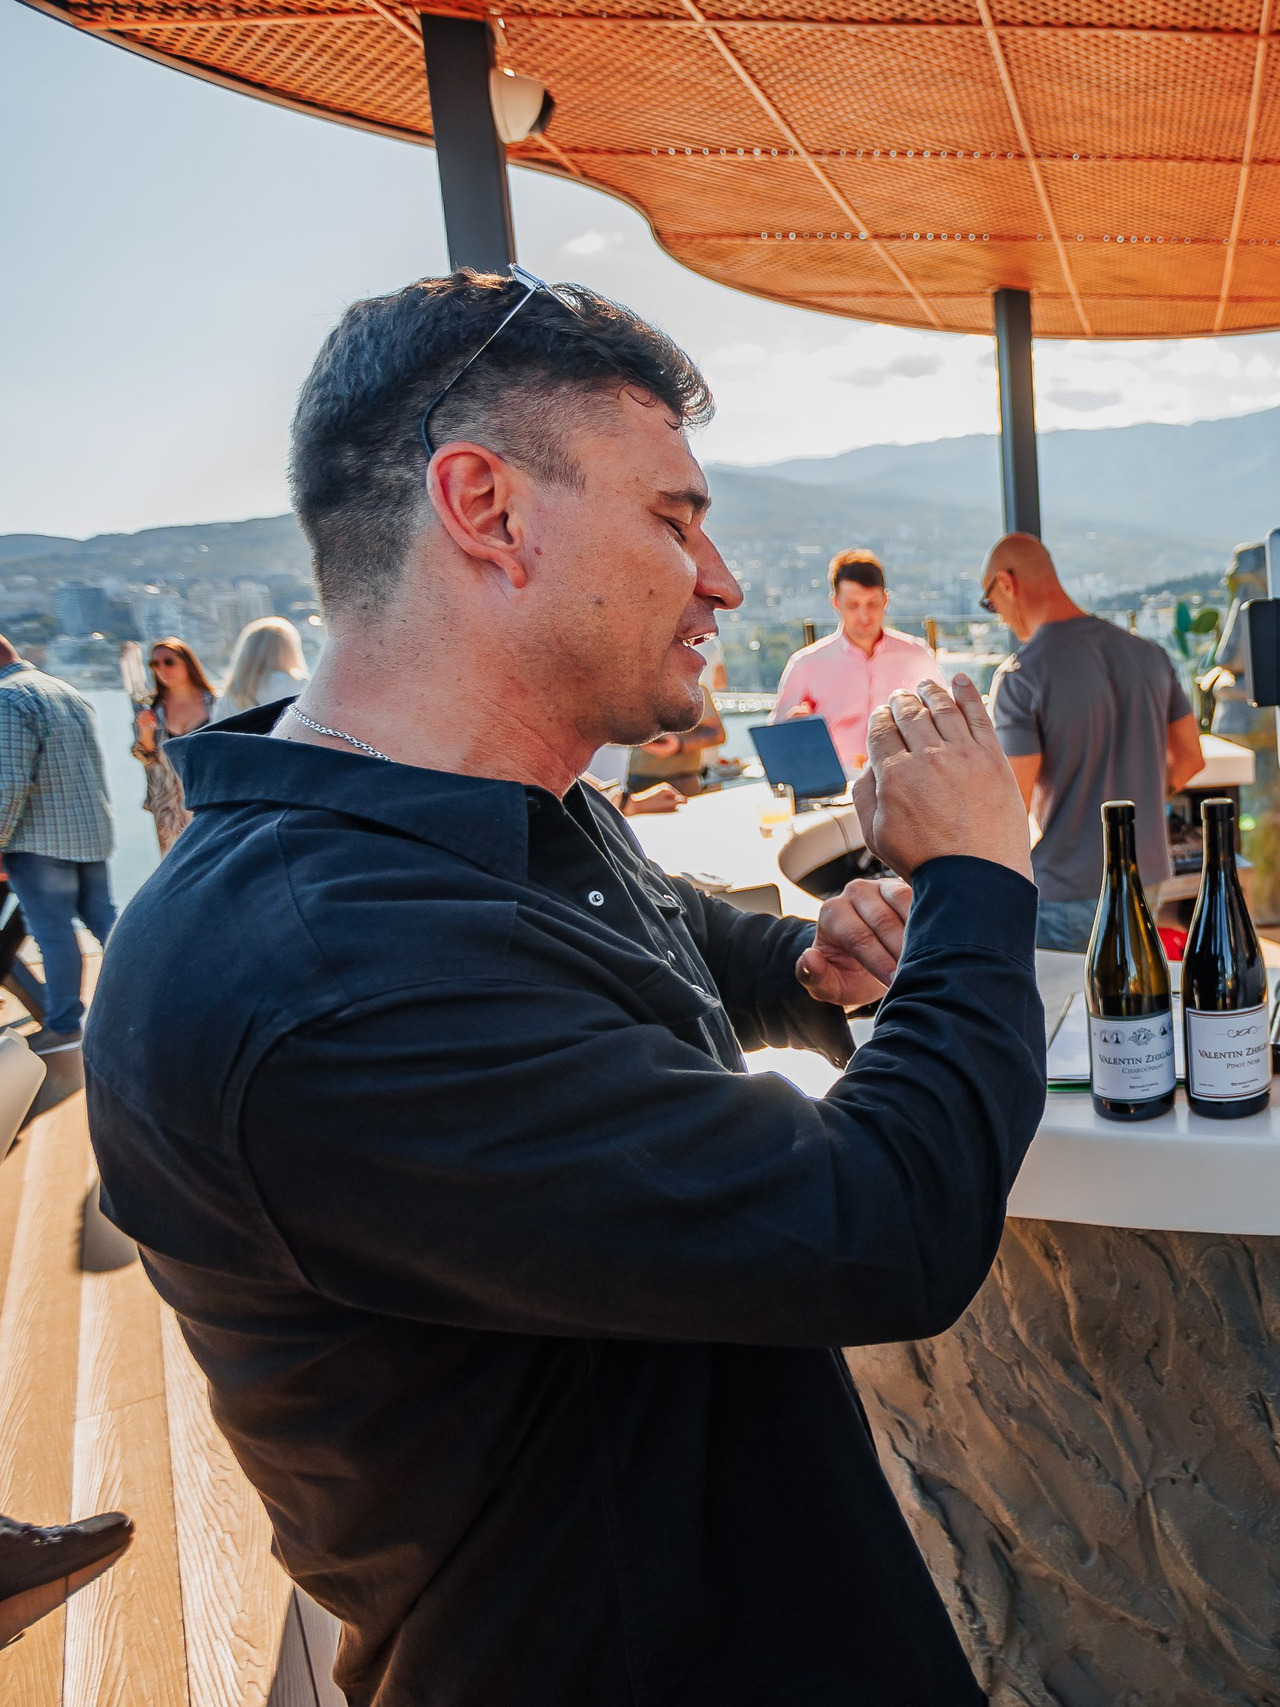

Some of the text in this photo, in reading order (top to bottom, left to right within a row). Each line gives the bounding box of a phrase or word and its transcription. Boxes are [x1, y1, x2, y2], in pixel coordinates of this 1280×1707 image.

[1098, 1054, 1142, 1066] VALENTIN
[1198, 1049, 1243, 1059] VALENTIN
[1226, 1058, 1261, 1070] PINOT NOIR
